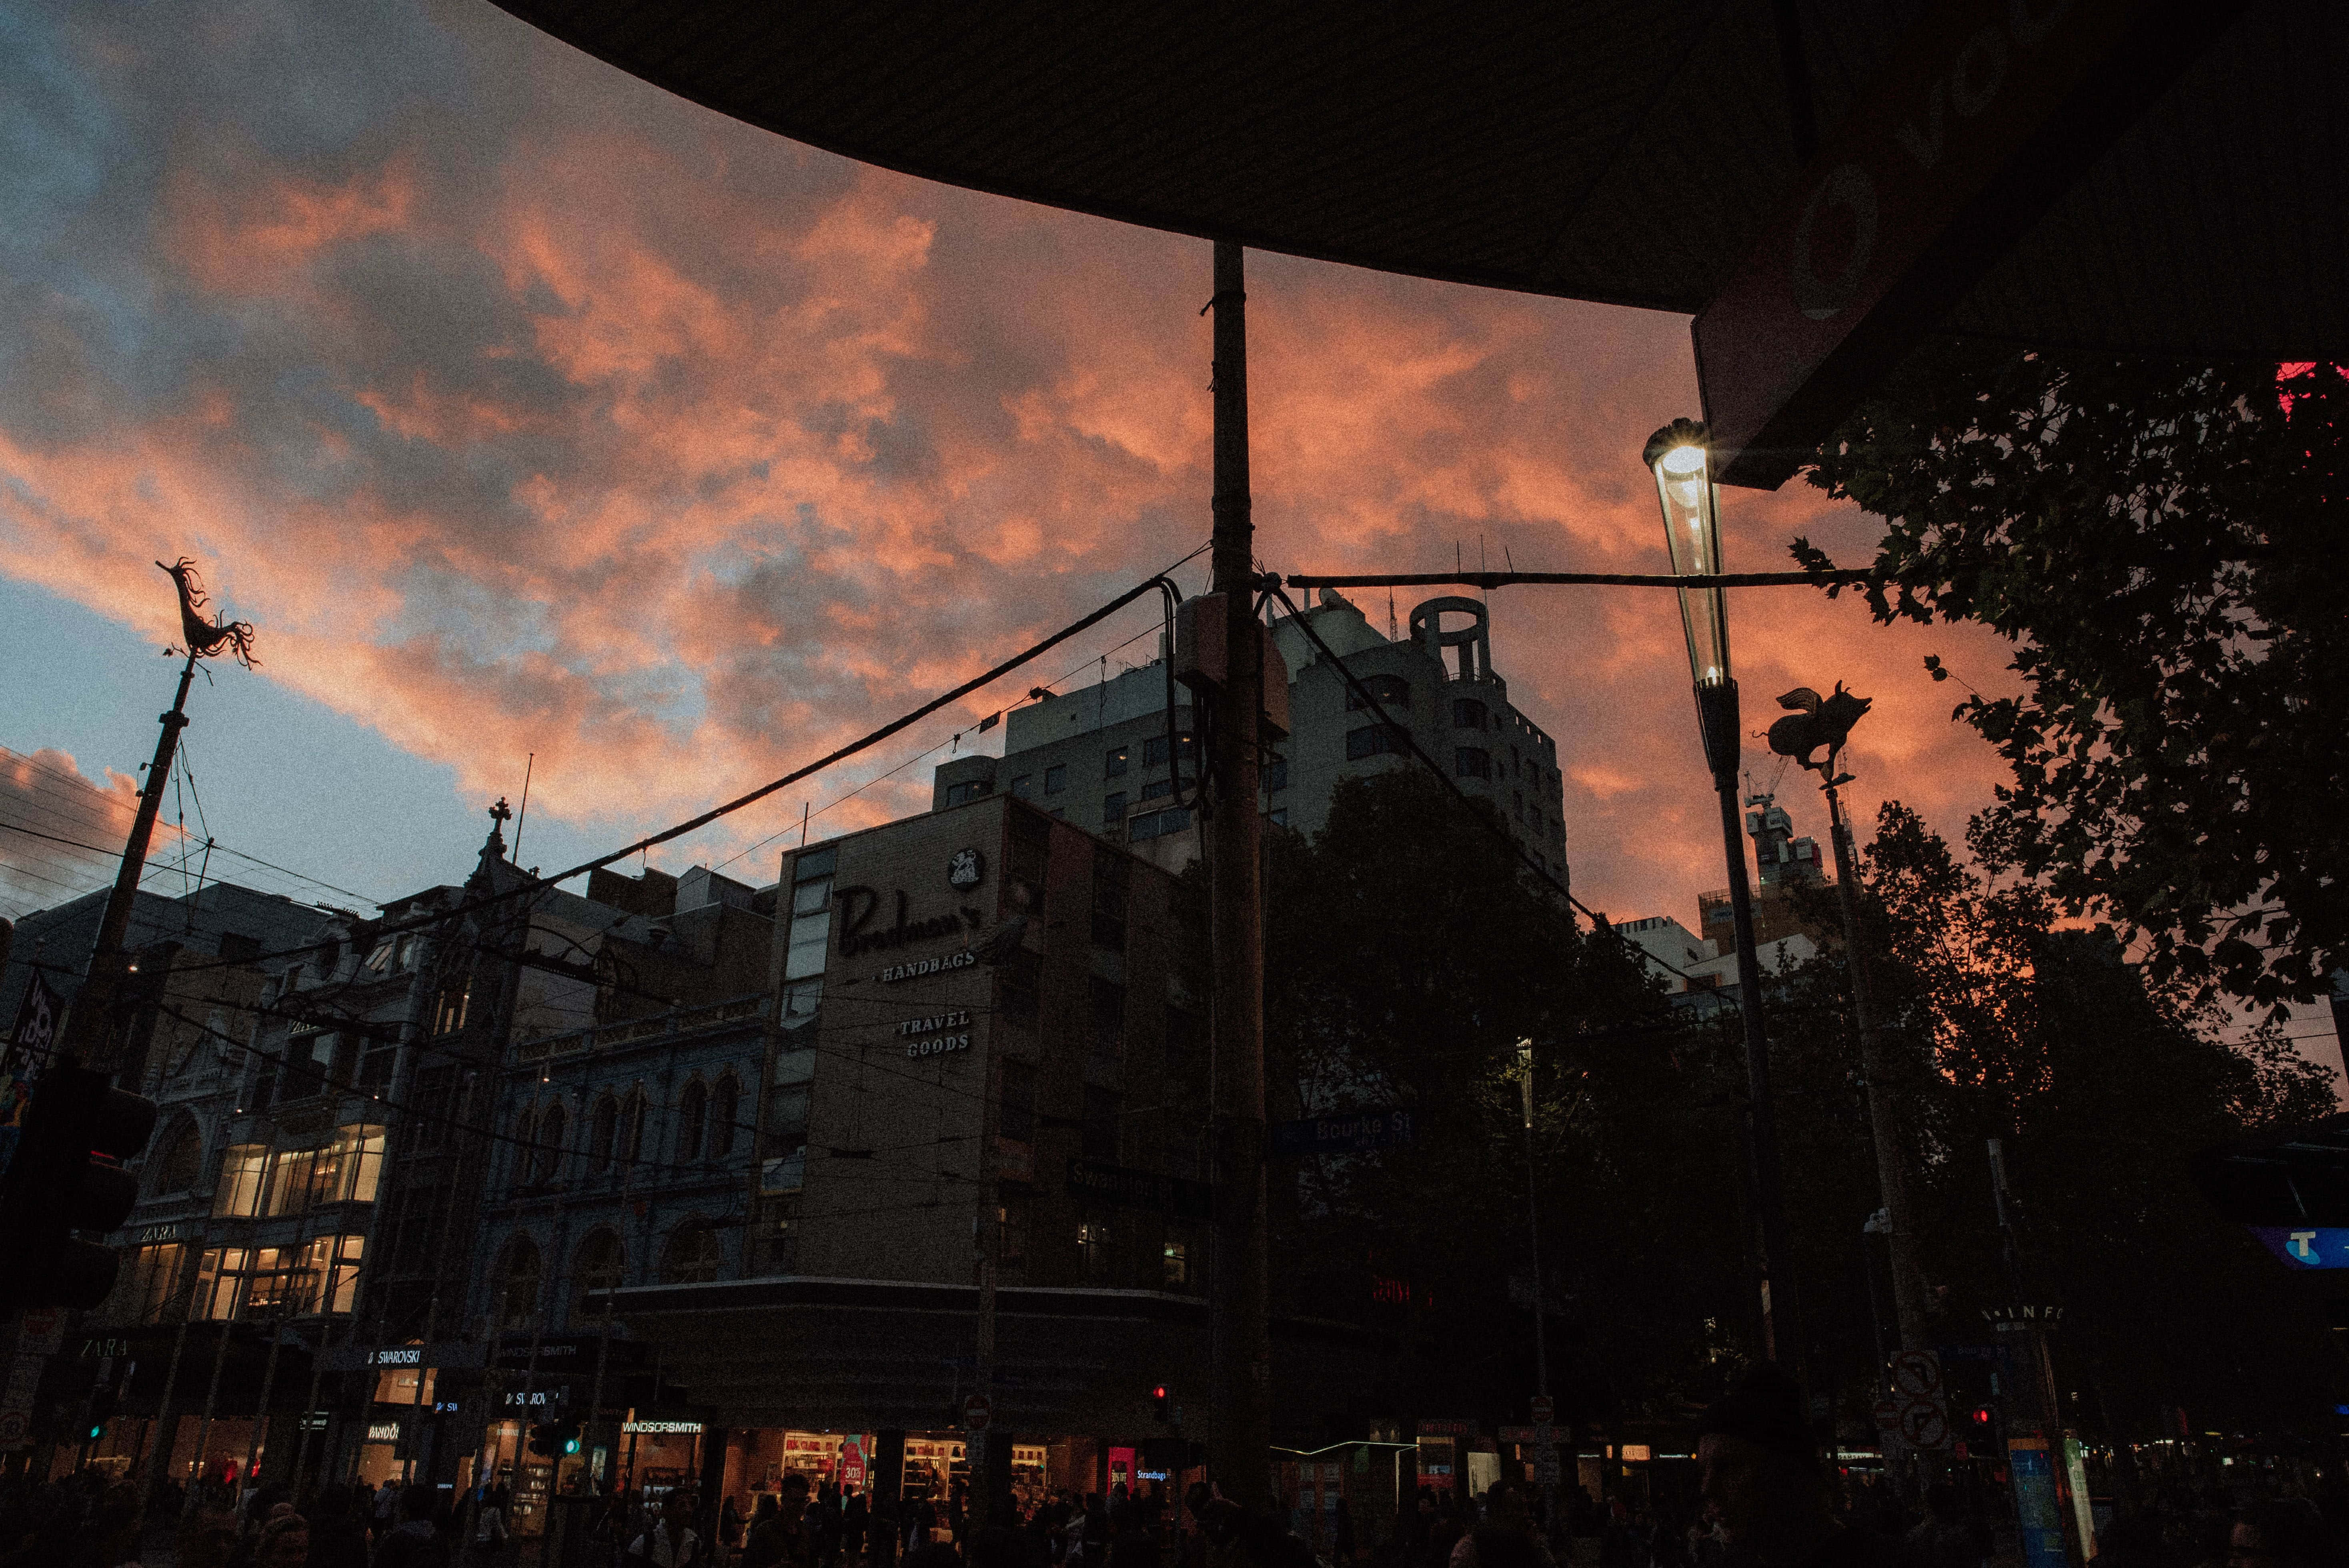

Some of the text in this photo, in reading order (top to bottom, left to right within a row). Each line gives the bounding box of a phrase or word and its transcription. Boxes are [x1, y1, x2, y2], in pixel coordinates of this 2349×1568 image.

[883, 951, 975, 982] HANDBAGS
[901, 1010, 970, 1035] TRAVEL
[907, 1034, 969, 1057] GOODS
[1316, 1115, 1382, 1140] Bourke
[141, 1224, 177, 1242] ZARA
[80, 1338, 128, 1358] ZARA
[378, 1350, 421, 1364] SWAROVSKI
[845, 1467, 861, 1479] 30%
[1137, 1469, 1166, 1481] Strandbags
